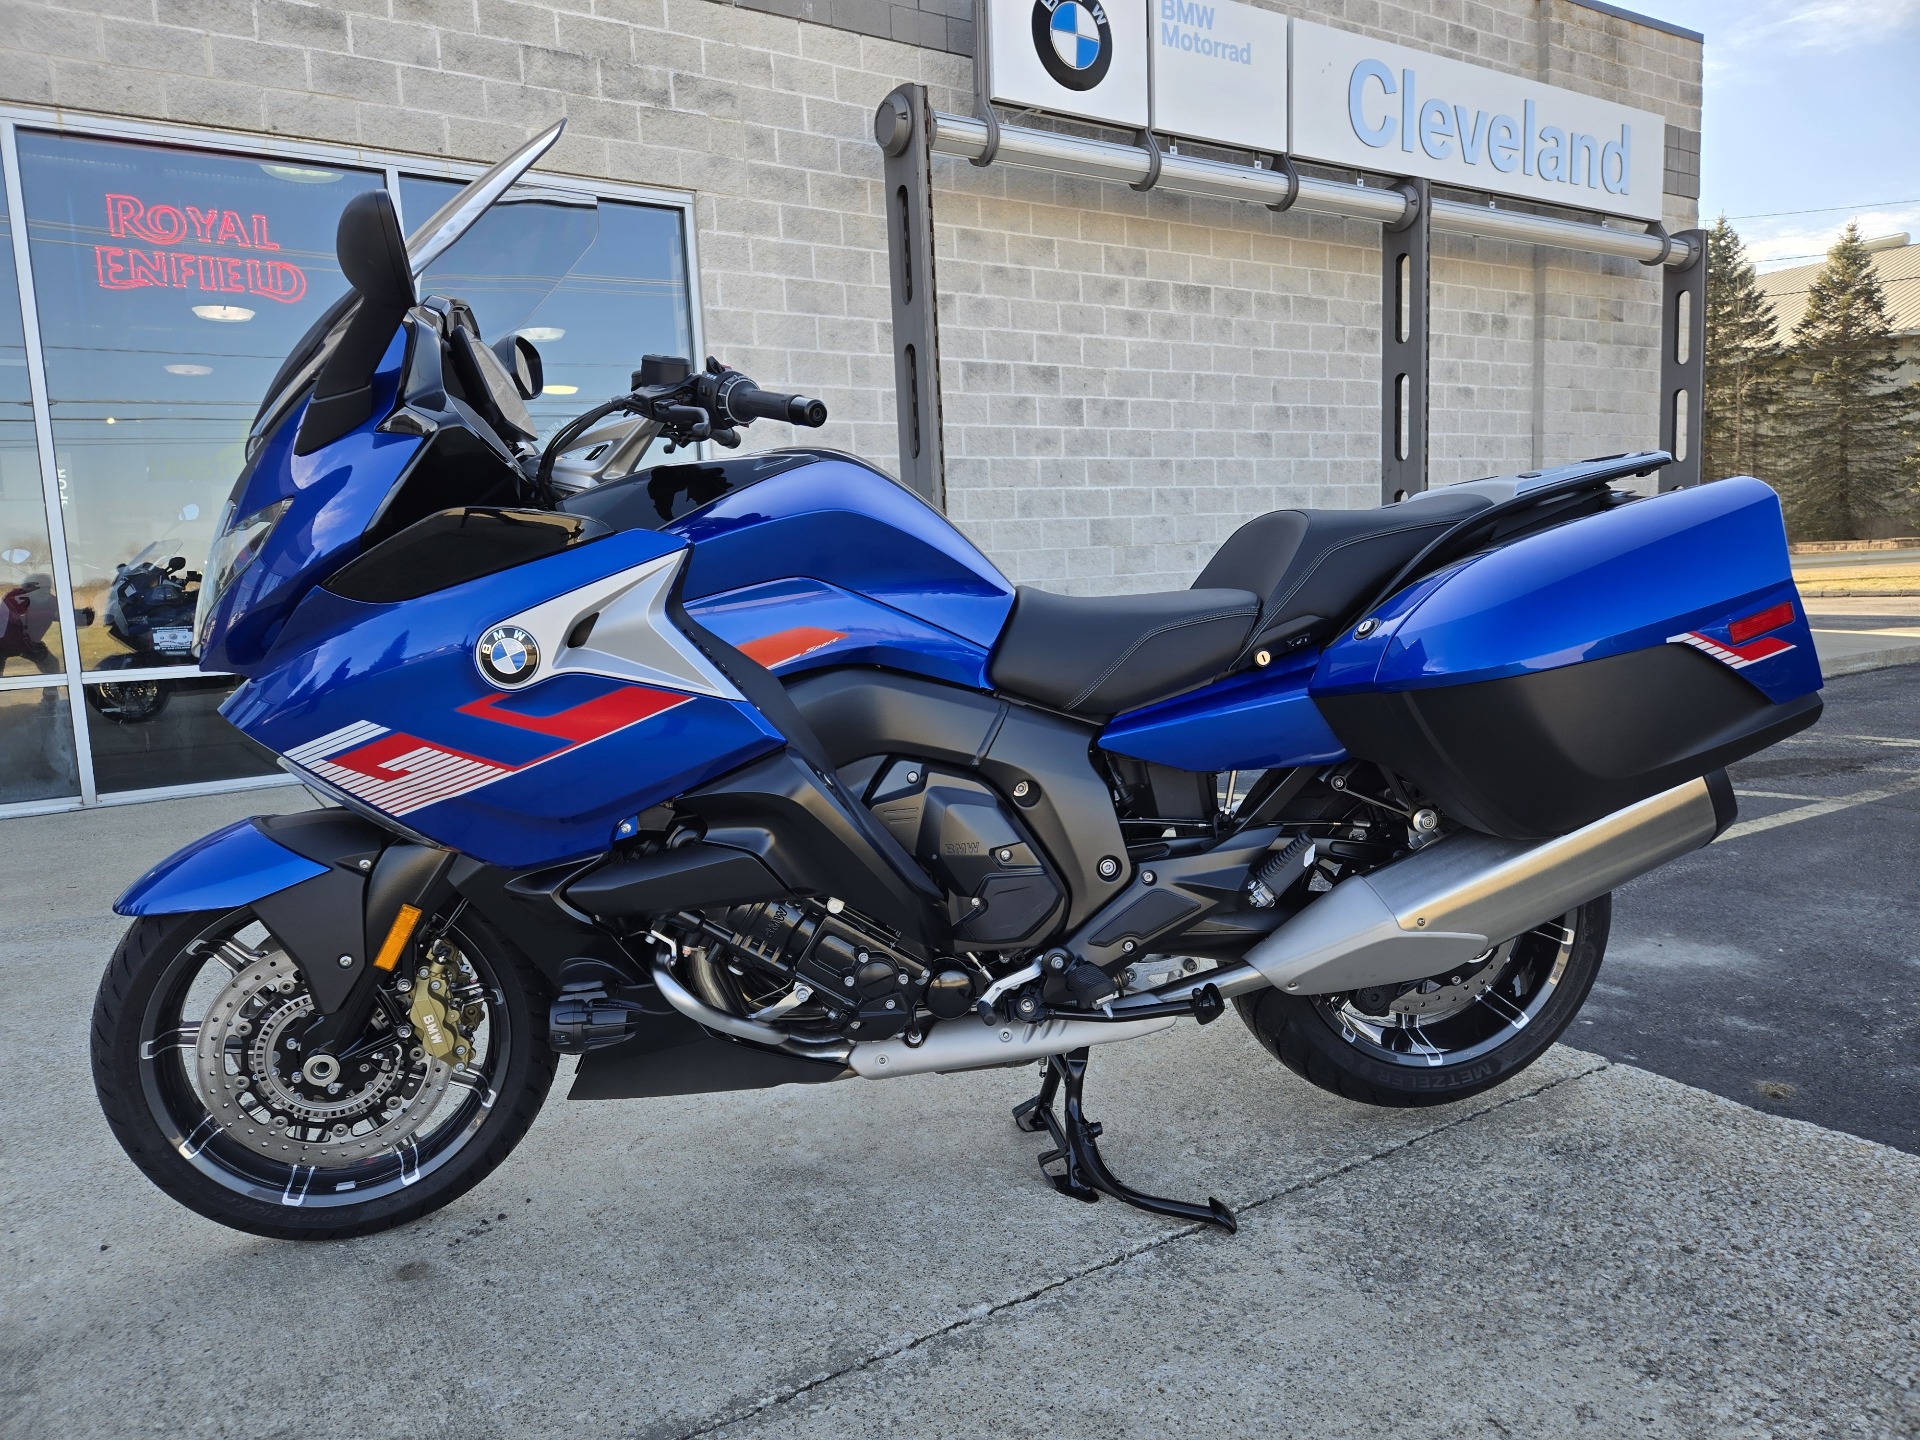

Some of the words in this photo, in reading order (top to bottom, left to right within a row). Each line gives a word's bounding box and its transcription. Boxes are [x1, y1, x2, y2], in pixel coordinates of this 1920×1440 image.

[1161, 0, 1215, 30] BMW
[1161, 23, 1252, 65] Motorrad
[1348, 58, 1631, 195] Cleveland
[106, 193, 280, 250] ROYAL
[95, 246, 307, 304] ENFIELD
[482, 629, 525, 654] BMW
[945, 842, 980, 854] BMW
[422, 1014, 443, 1044] BMW
[1377, 1062, 1493, 1089] METZELER
